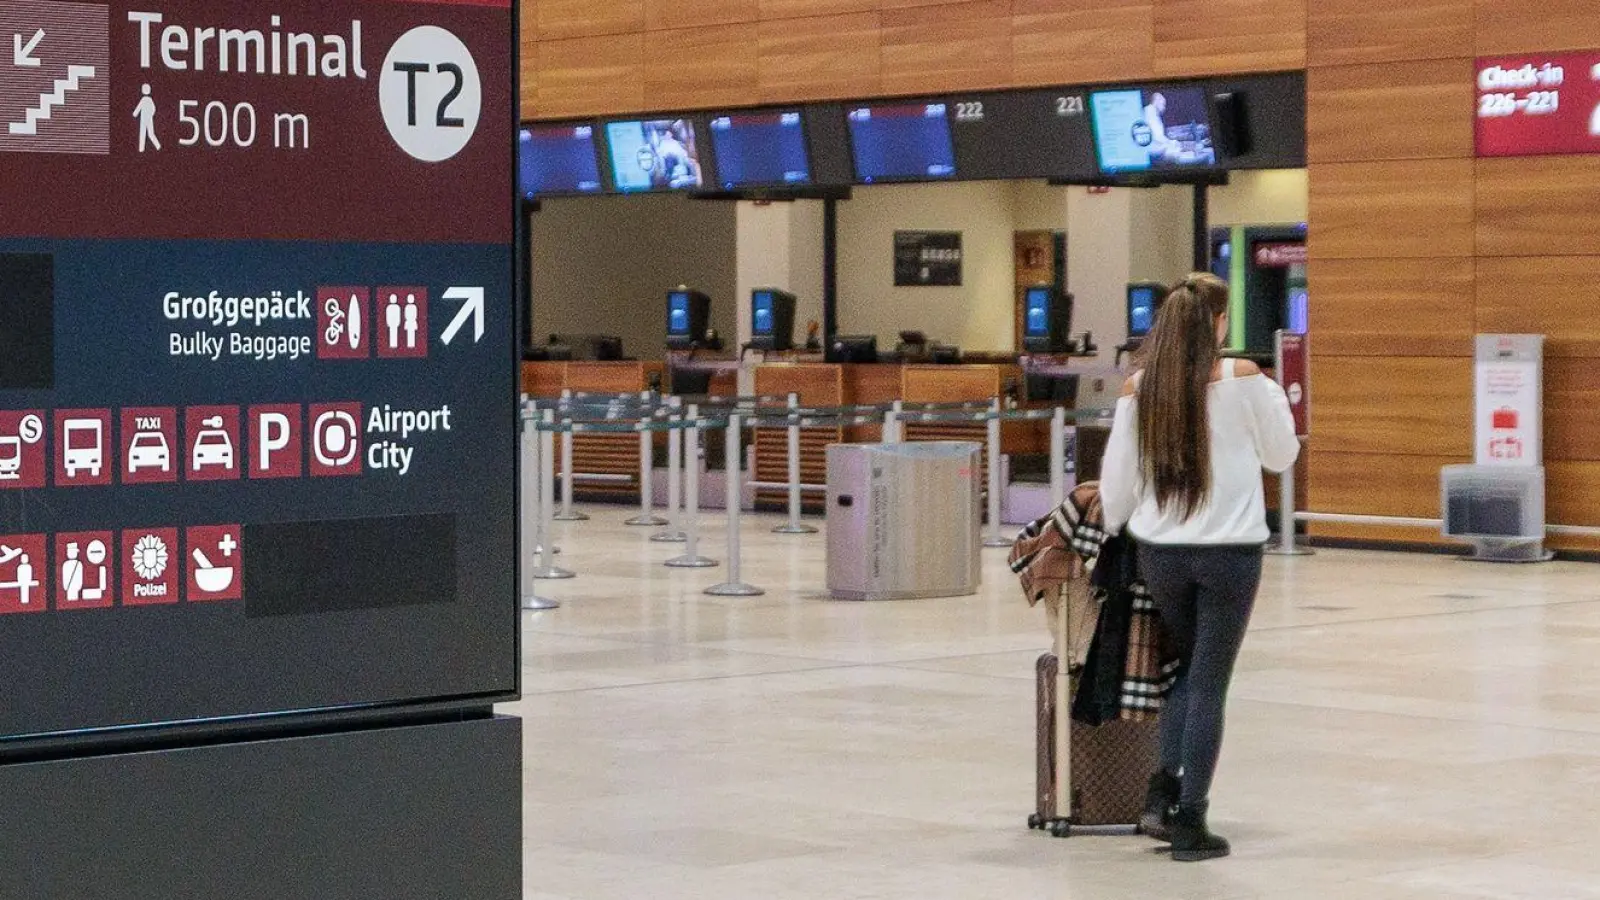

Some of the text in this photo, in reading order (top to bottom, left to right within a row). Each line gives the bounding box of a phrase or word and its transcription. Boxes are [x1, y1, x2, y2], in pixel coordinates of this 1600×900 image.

[128, 11, 367, 79] Terminal
[1478, 62, 1564, 90] Check-in
[393, 61, 464, 128] T2
[956, 101, 984, 119] 222
[1057, 96, 1084, 115] 221
[178, 99, 309, 149] 500 m
[163, 290, 311, 326] Großgepäck
[169, 331, 311, 361] Bulky Baggage
[24, 418, 38, 439] S
[135, 417, 161, 429] TAXI
[367, 404, 451, 439] Airport
[259, 412, 291, 470] P
[368, 440, 414, 475] City
[133, 582, 167, 597] Polizei
